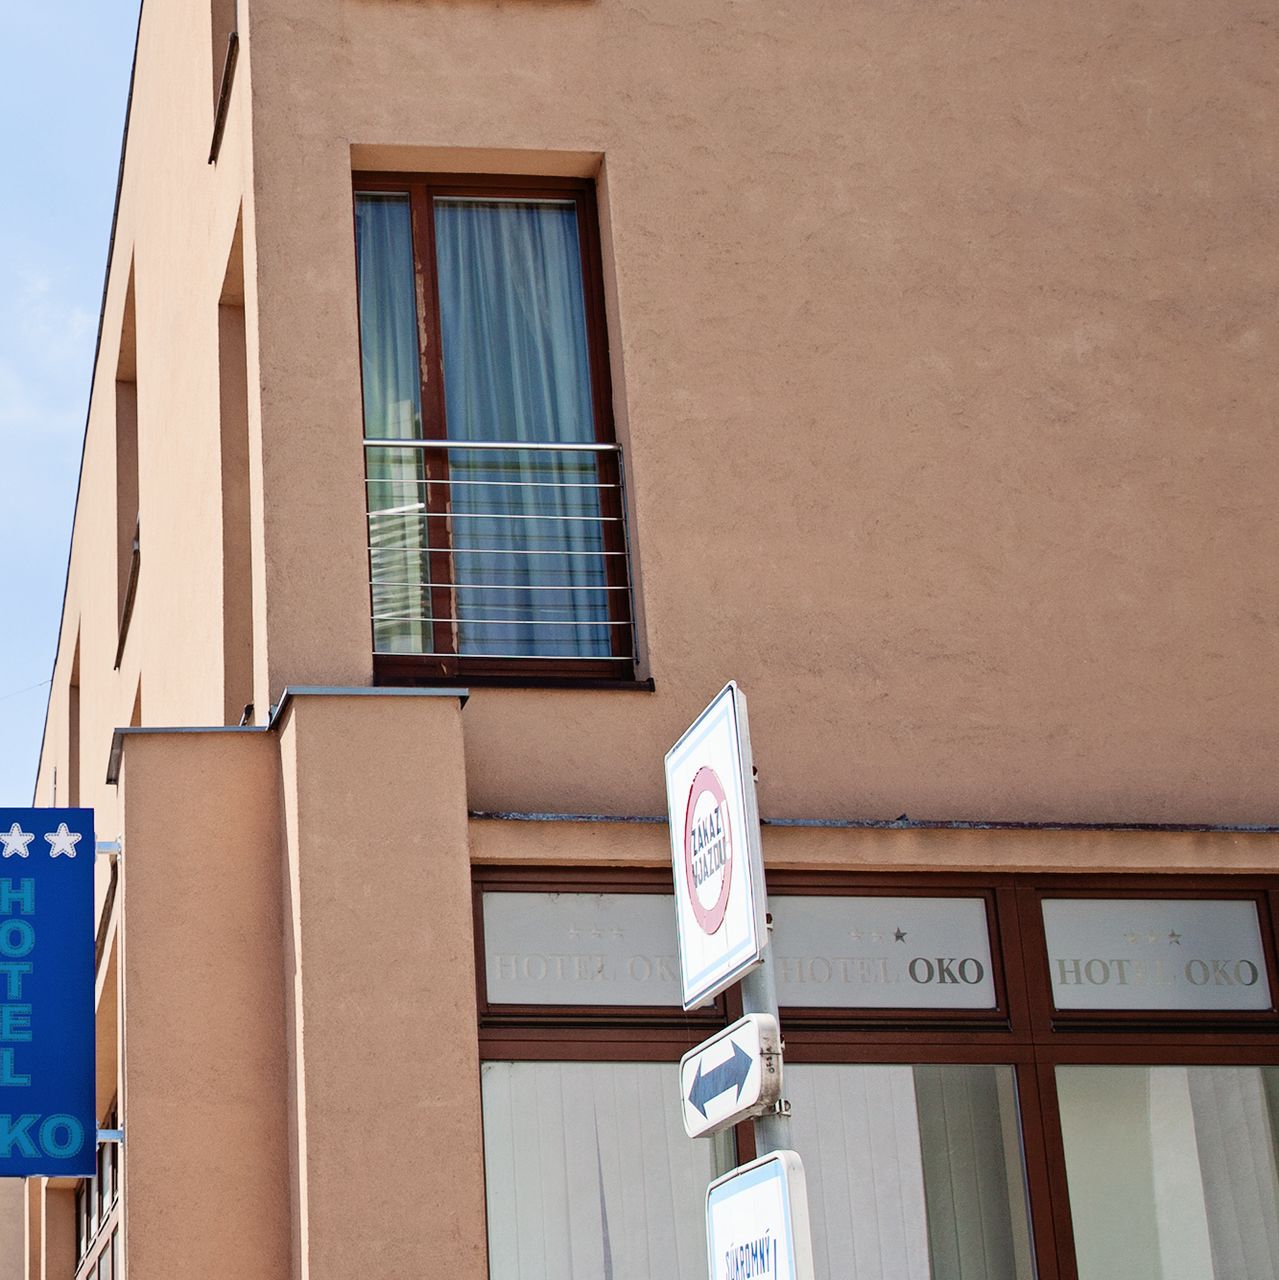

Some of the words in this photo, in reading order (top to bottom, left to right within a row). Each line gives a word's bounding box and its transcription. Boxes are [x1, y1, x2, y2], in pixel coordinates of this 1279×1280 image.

[691, 806, 722, 856] ZÁKAZ
[629, 953, 680, 982] OK
[777, 956, 900, 984] HOTEL
[908, 956, 985, 985] OKO
[1183, 958, 1259, 986] OKO
